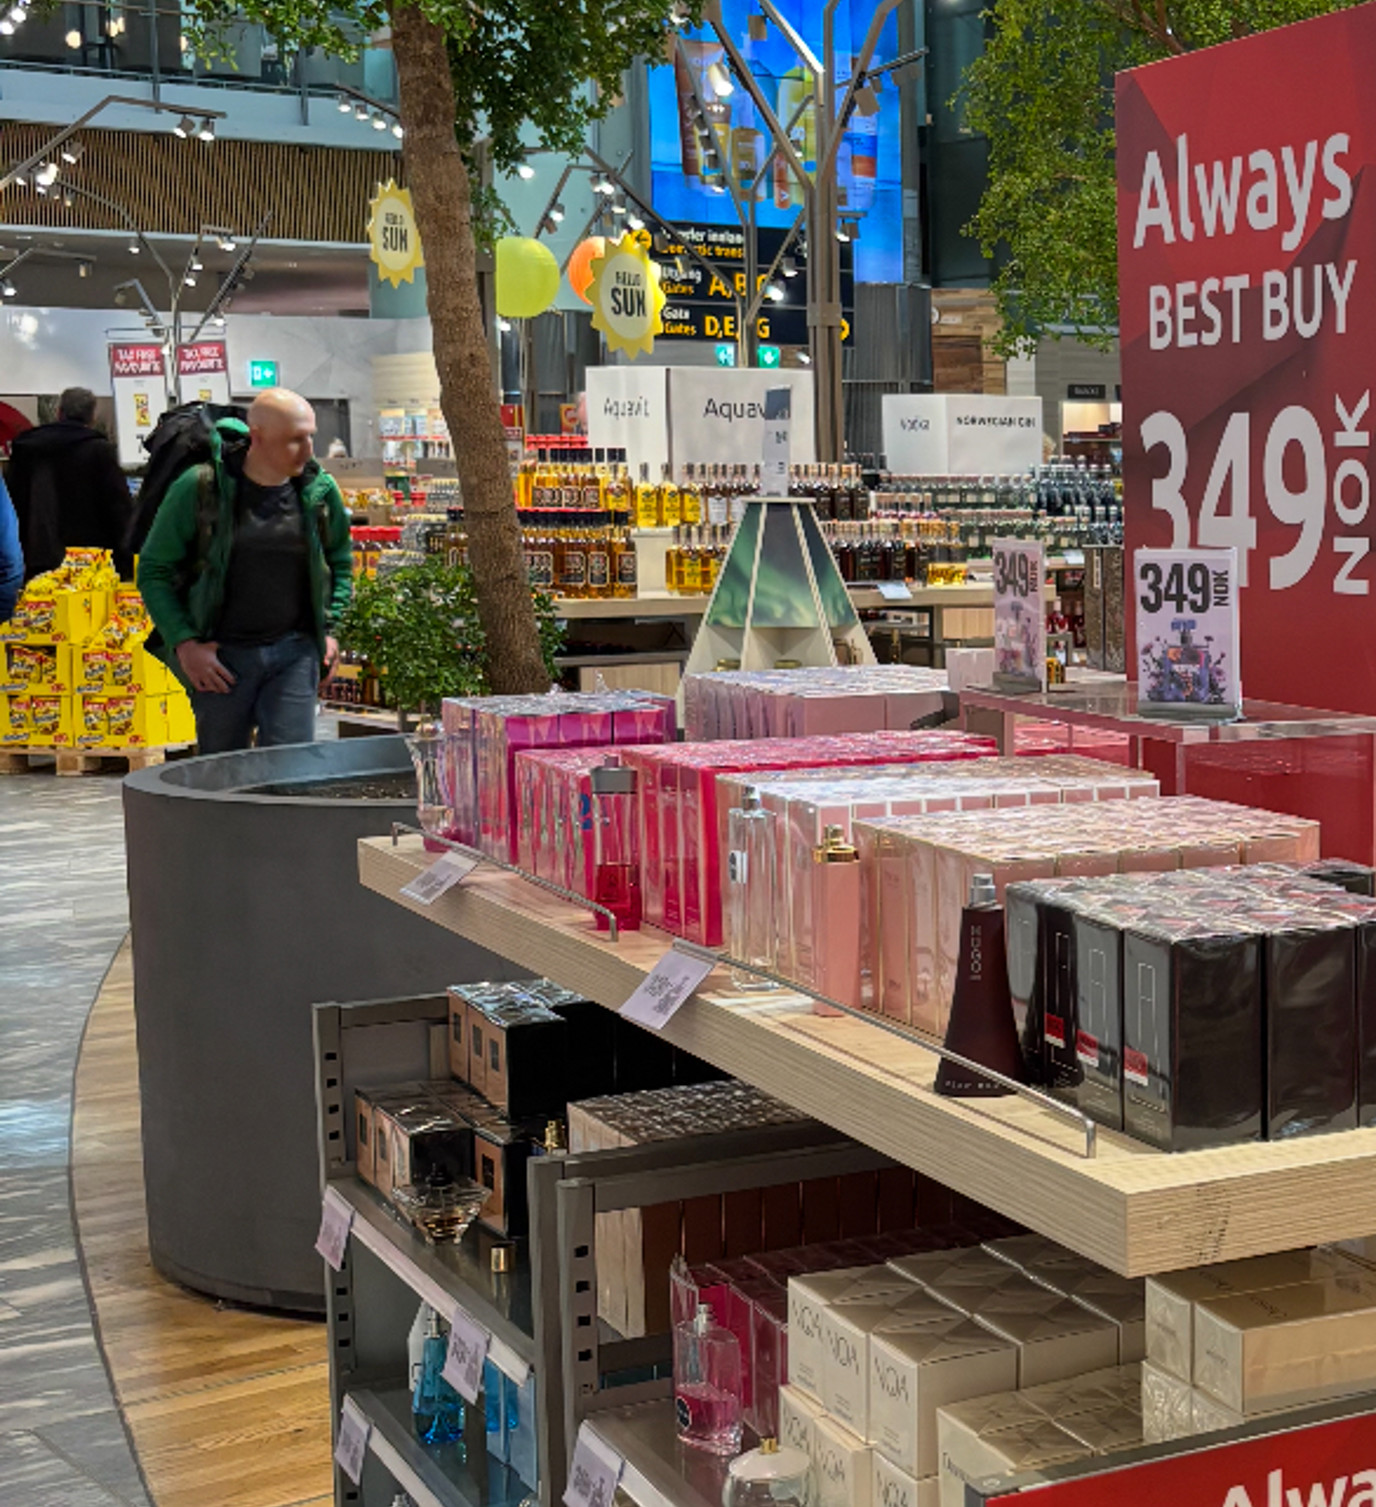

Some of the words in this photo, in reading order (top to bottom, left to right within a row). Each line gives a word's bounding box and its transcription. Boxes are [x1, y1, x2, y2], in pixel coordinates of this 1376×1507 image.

[1133, 131, 1352, 251] Always
[382, 226, 408, 253] SUN
[611, 287, 647, 318] SUN
[1149, 273, 1250, 351] BEST
[1261, 260, 1358, 335] BUY
[1139, 404, 1328, 592] 349
[1333, 389, 1371, 594] NOK
[994, 551, 1029, 598] 349
[1139, 562, 1210, 614] 349
[1212, 569, 1230, 607] NOK
